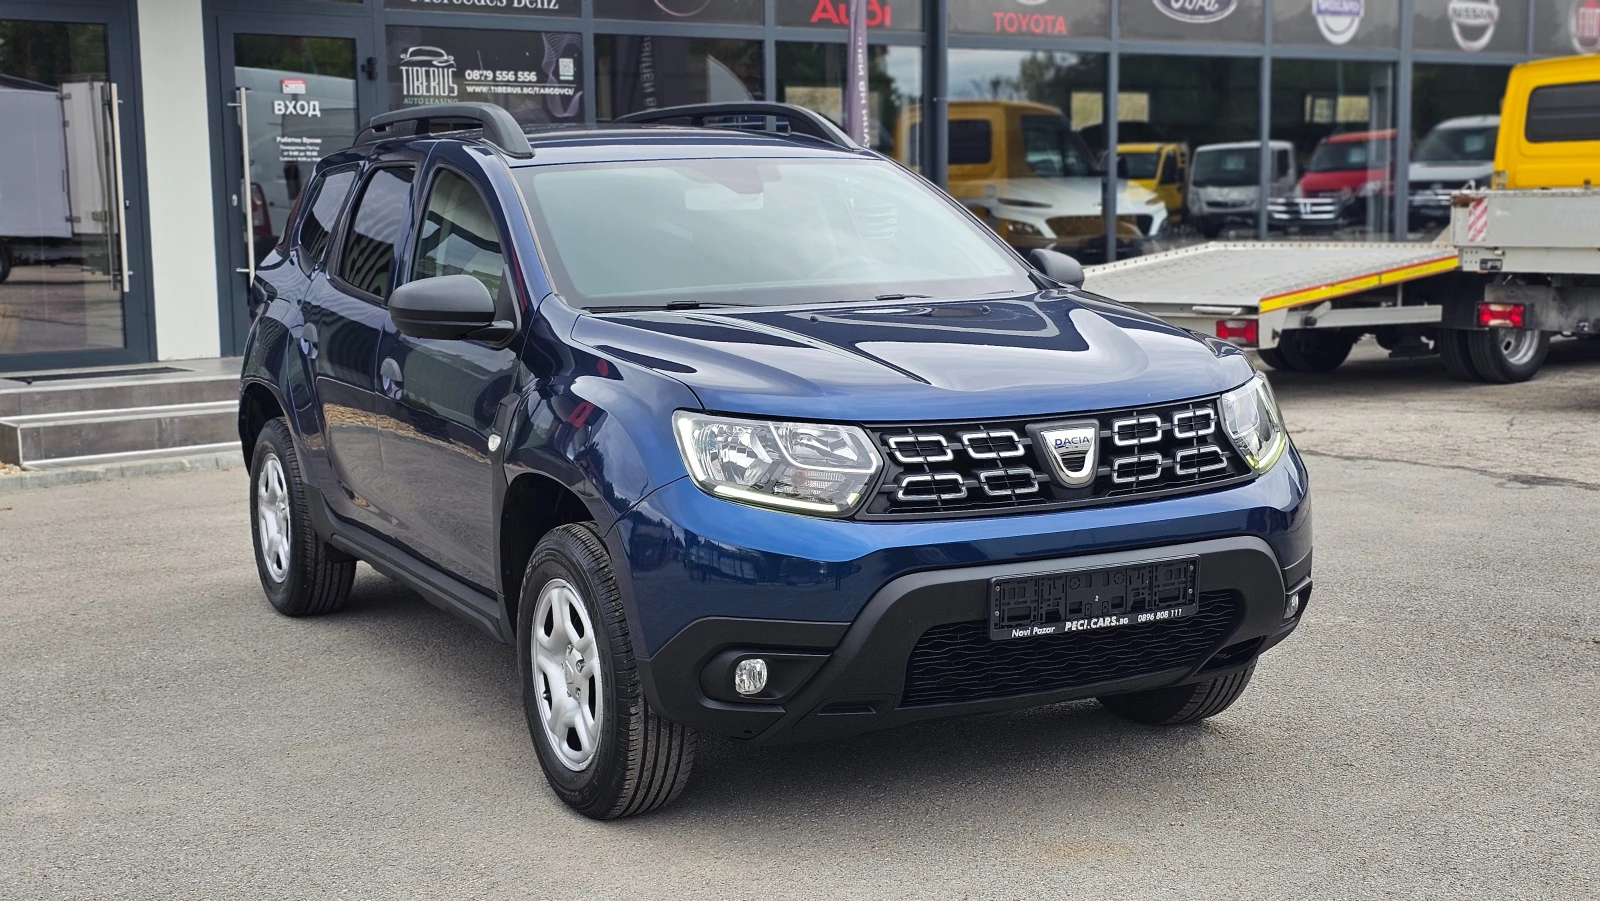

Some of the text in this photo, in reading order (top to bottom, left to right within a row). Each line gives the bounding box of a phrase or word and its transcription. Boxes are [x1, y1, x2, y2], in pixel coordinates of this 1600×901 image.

[1451, 7, 1496, 20] NISSAN
[992, 12, 1068, 35] TOYOTA
[399, 66, 458, 96] TIBERUS
[465, 69, 537, 82] 0879 556 556
[273, 100, 321, 117] ВХОД
[1054, 436, 1091, 447] DACIA
[1011, 608, 1182, 638] Novi Pazar PECI.CARS.BG 0896 808 111
